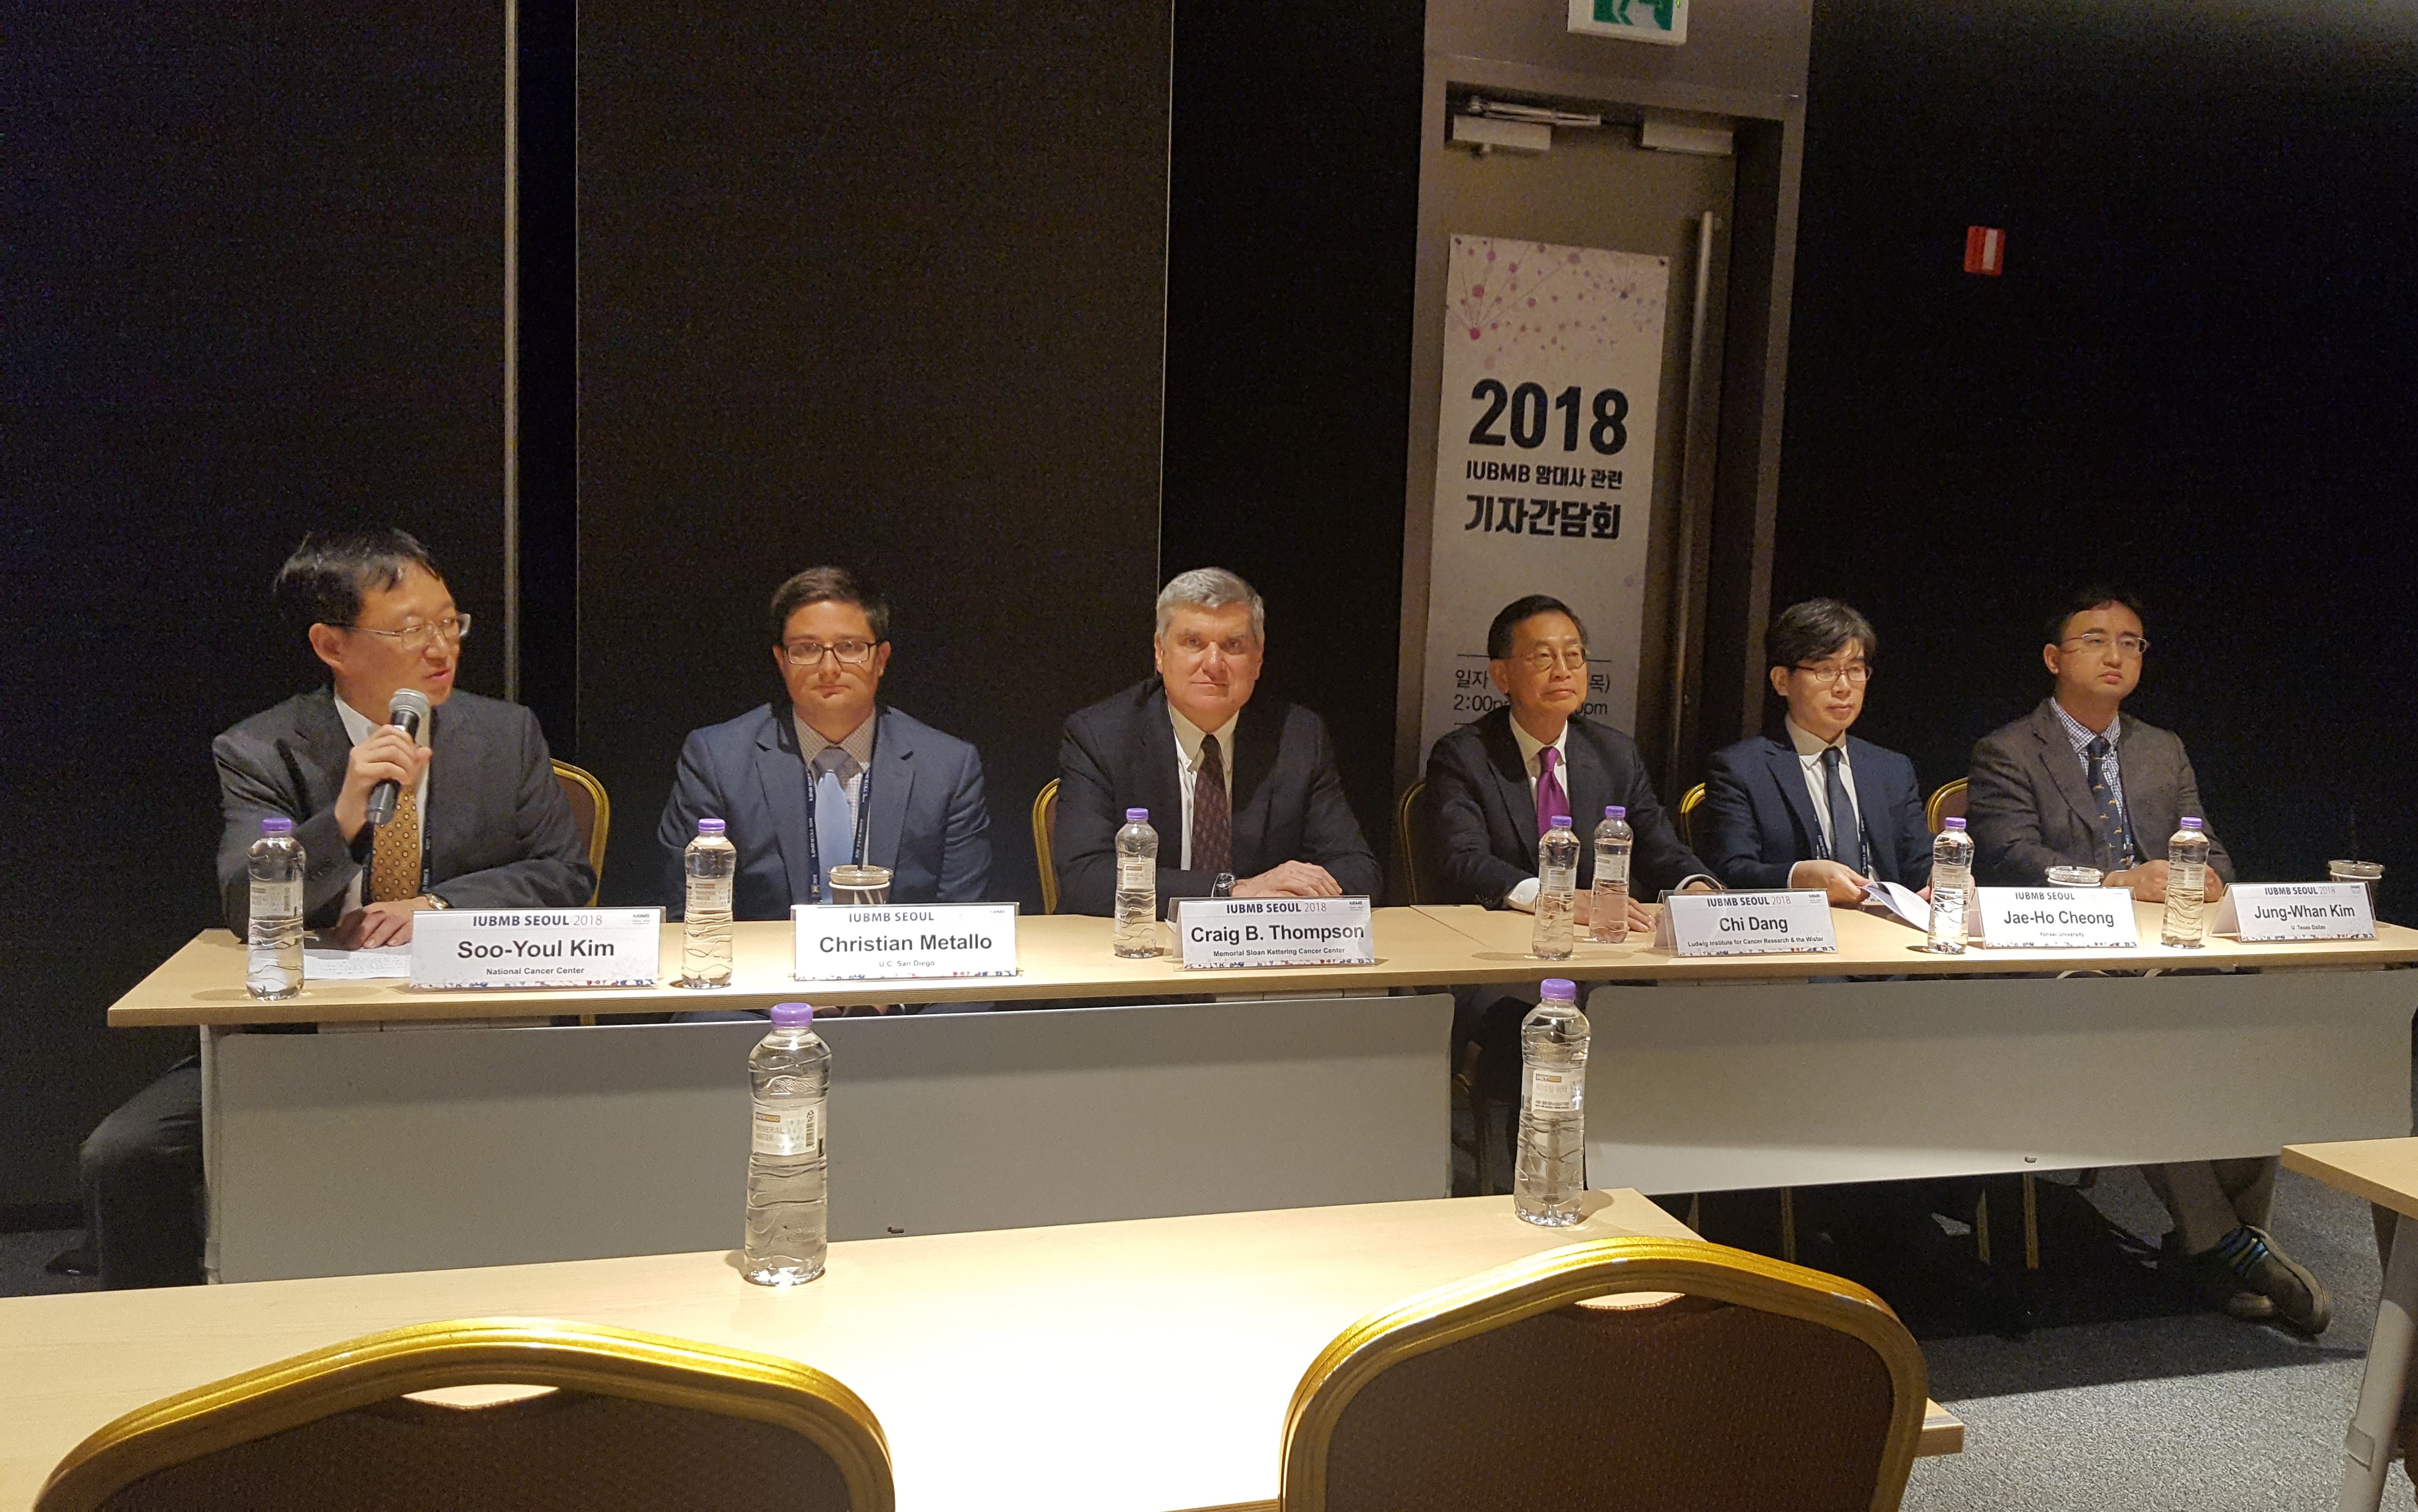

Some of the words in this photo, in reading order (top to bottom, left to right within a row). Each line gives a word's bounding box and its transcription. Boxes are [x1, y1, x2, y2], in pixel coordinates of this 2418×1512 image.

[1468, 378, 1629, 455] 2018
[1466, 460, 1531, 483] IUBMB
[1536, 465, 1586, 487] 암대사
[1590, 468, 1623, 490] 관련
[1464, 494, 1621, 540] 기자간담회
[1456, 670, 1488, 689] 일자
[2015, 892, 2045, 900] IUBMB
[2046, 892, 2075, 900] SEOUL
[2265, 887, 2291, 895] IUBMB
[2293, 887, 2318, 895] SEOUL
[2320, 886, 2336, 894] 2018
[1226, 903, 1264, 914] IUBMB
[1266, 903, 1302, 913] SEOUL
[1304, 902, 1327, 912] 2018
[1707, 898, 1738, 907] IUBMB
[1741, 896, 1770, 906] SEOUL
[1772, 896, 1791, 905] 2018
[472, 916, 520, 926] IUBMB
[524, 915, 570, 926] SEOUL
[573, 915, 603, 926] 2018
[849, 912, 891, 923] IUBMB
[895, 911, 935, 922] SEOUL
[2004, 910, 2055, 924] Jae-Ho
[2058, 910, 2114, 927] Cheong
[2254, 904, 2327, 921] Jung-Whan
[2329, 904, 2355, 917] Kim
[1720, 917, 1745, 931] Chi
[1749, 917, 1789, 933] Dang
[1191, 926, 1239, 945] Craig
[1246, 925, 1264, 941] B.
[1268, 924, 1364, 943] Thompson
[457, 940, 562, 959] Soo-Youl
[570, 939, 615, 957] Kim
[819, 935, 913, 953] Christian
[920, 934, 992, 950] Metallo
